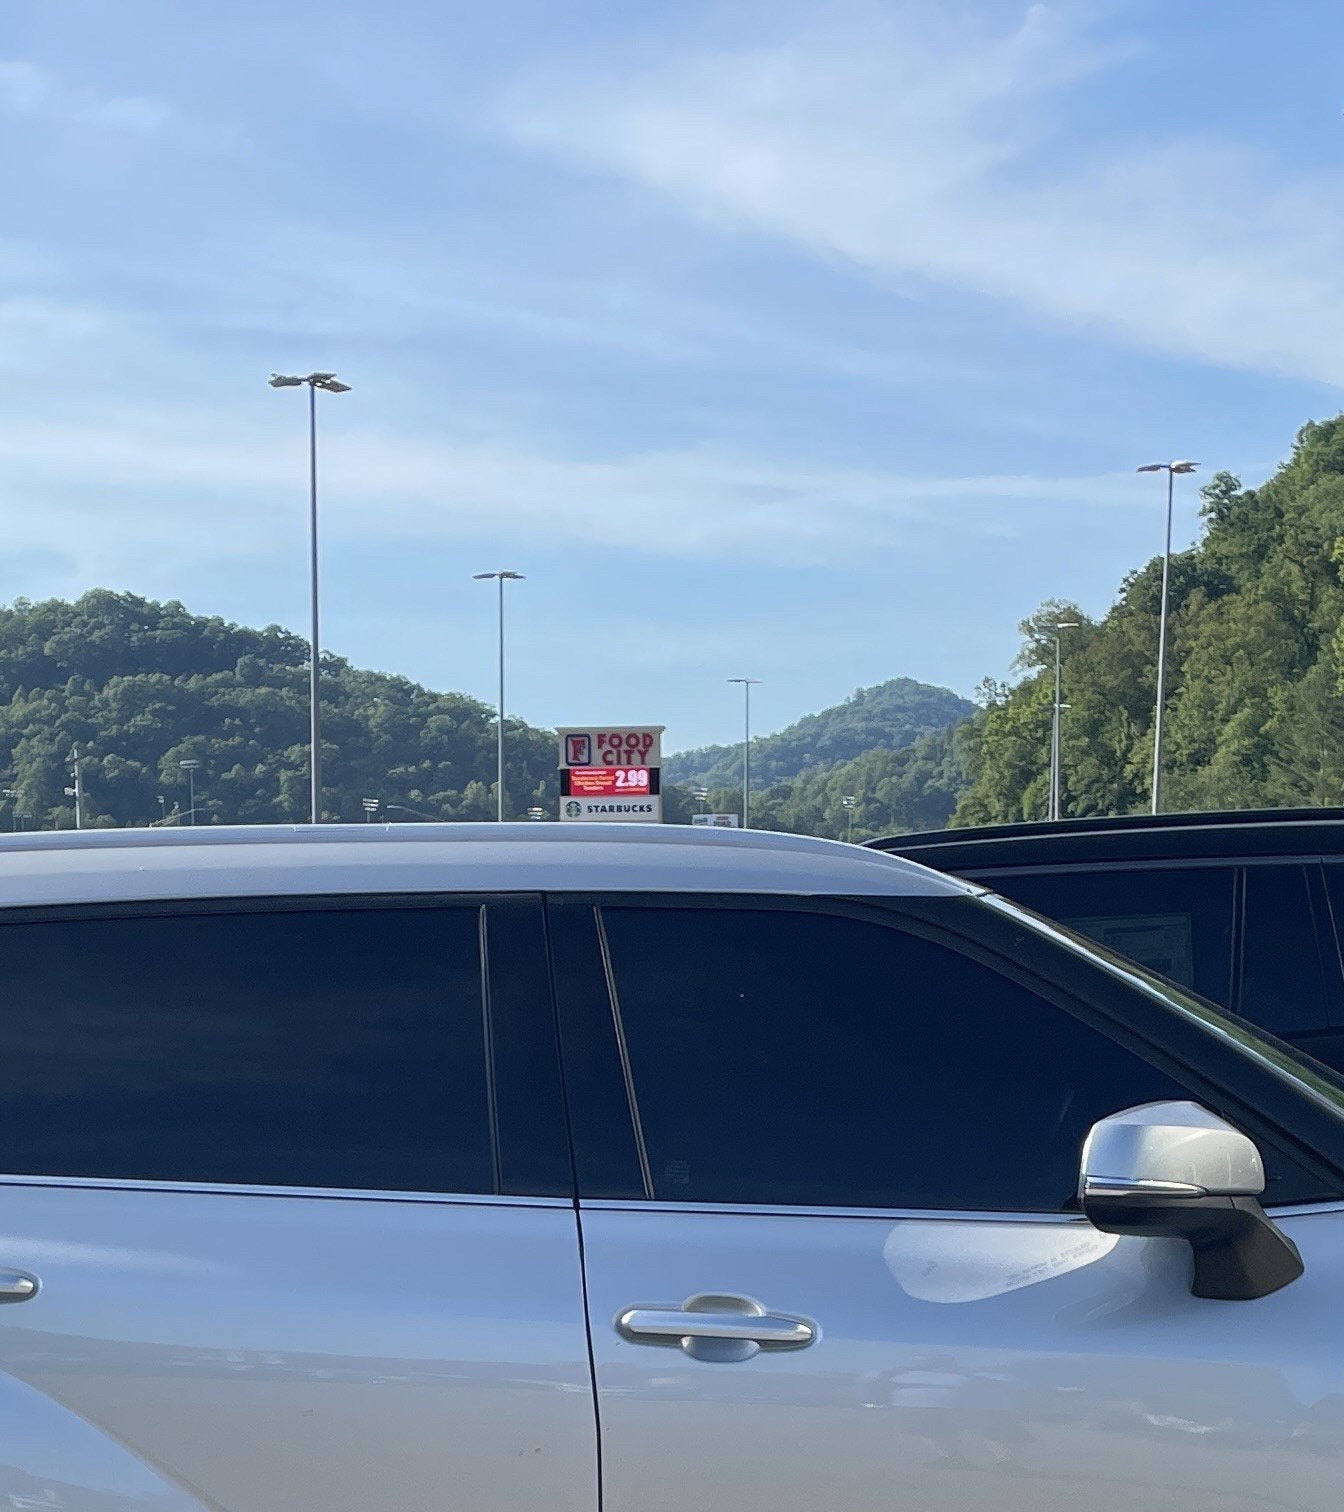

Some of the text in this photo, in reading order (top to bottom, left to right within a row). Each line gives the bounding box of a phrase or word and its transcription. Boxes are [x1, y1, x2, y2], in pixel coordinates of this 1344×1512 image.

[597, 733, 654, 749] FOOD
[602, 749, 649, 766] CITY
[615, 769, 648, 787] 2.99
[587, 804, 653, 813] STARBUCKS
